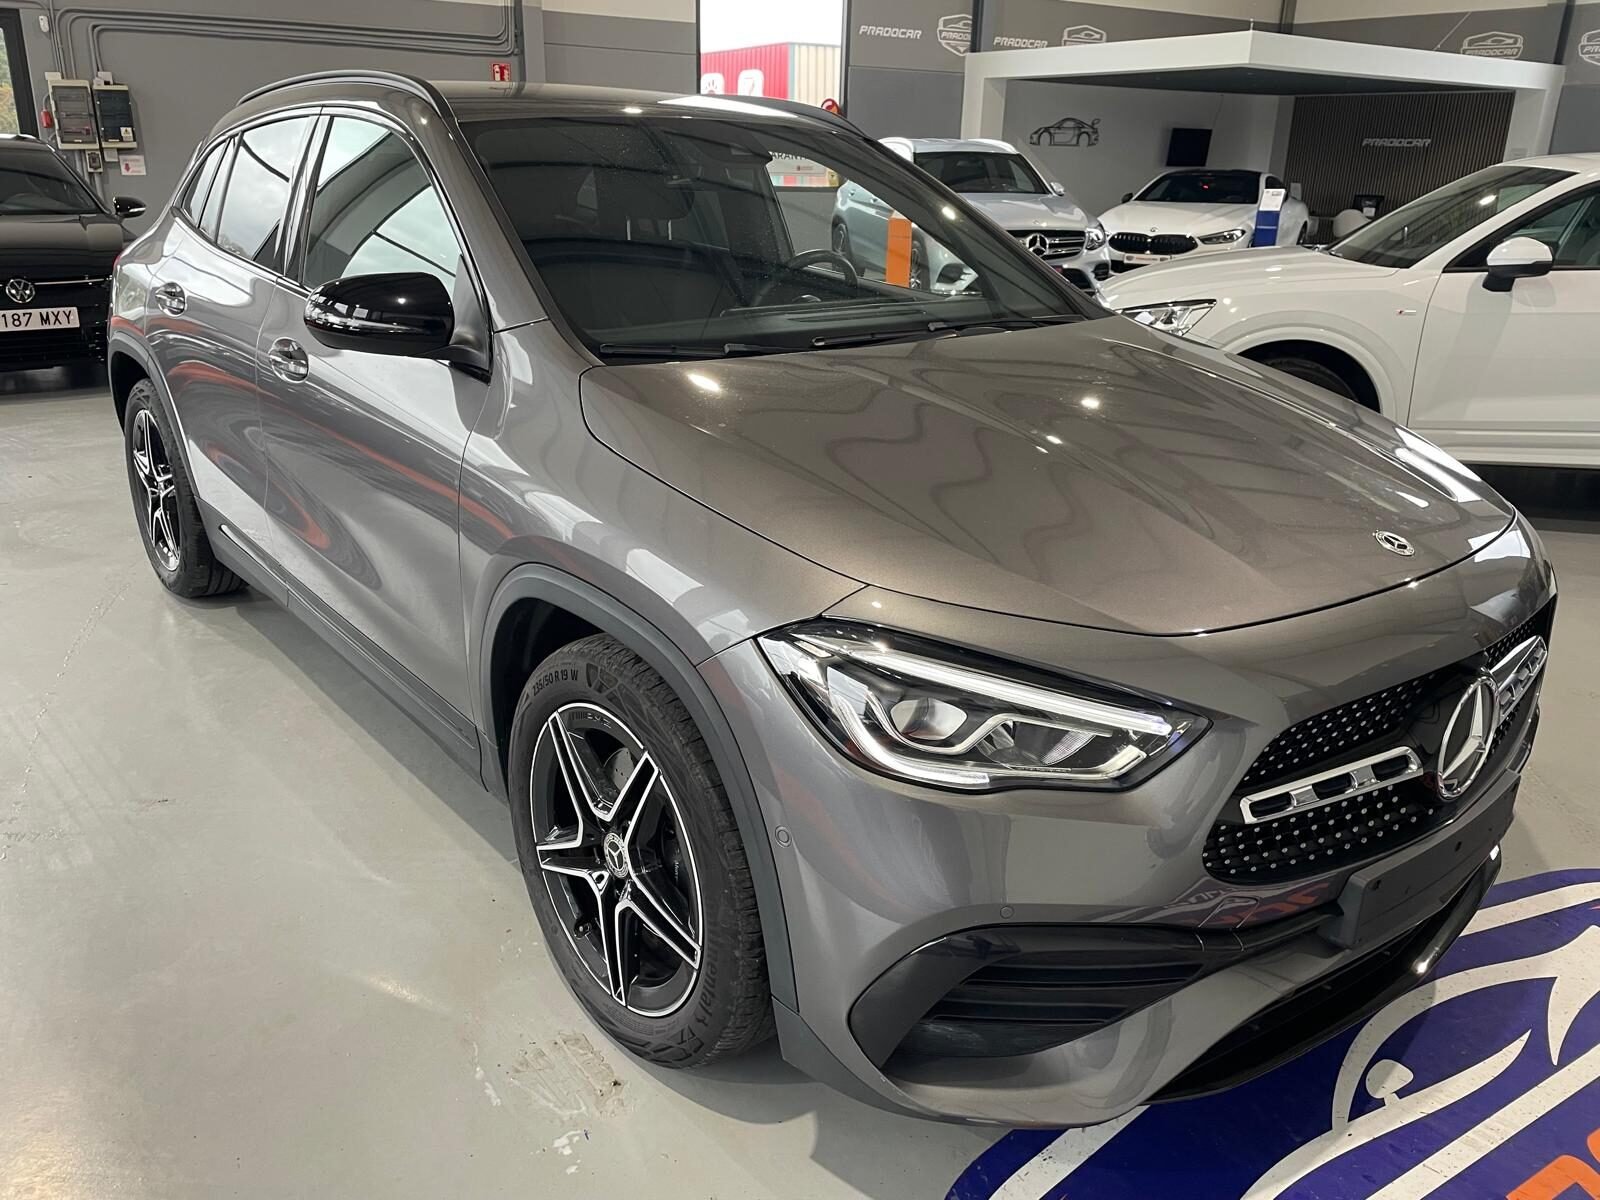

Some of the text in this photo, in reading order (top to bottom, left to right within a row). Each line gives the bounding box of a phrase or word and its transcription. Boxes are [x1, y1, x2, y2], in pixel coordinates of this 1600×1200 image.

[859, 25, 922, 39] PRADOCAR
[941, 31, 971, 40] PRADO
[993, 36, 1047, 48] PRADOCAR
[1362, 138, 1431, 147] PRADOCAR
[39, 310, 71, 326] MXY
[533, 668, 578, 696] 235/50 R 19 W
